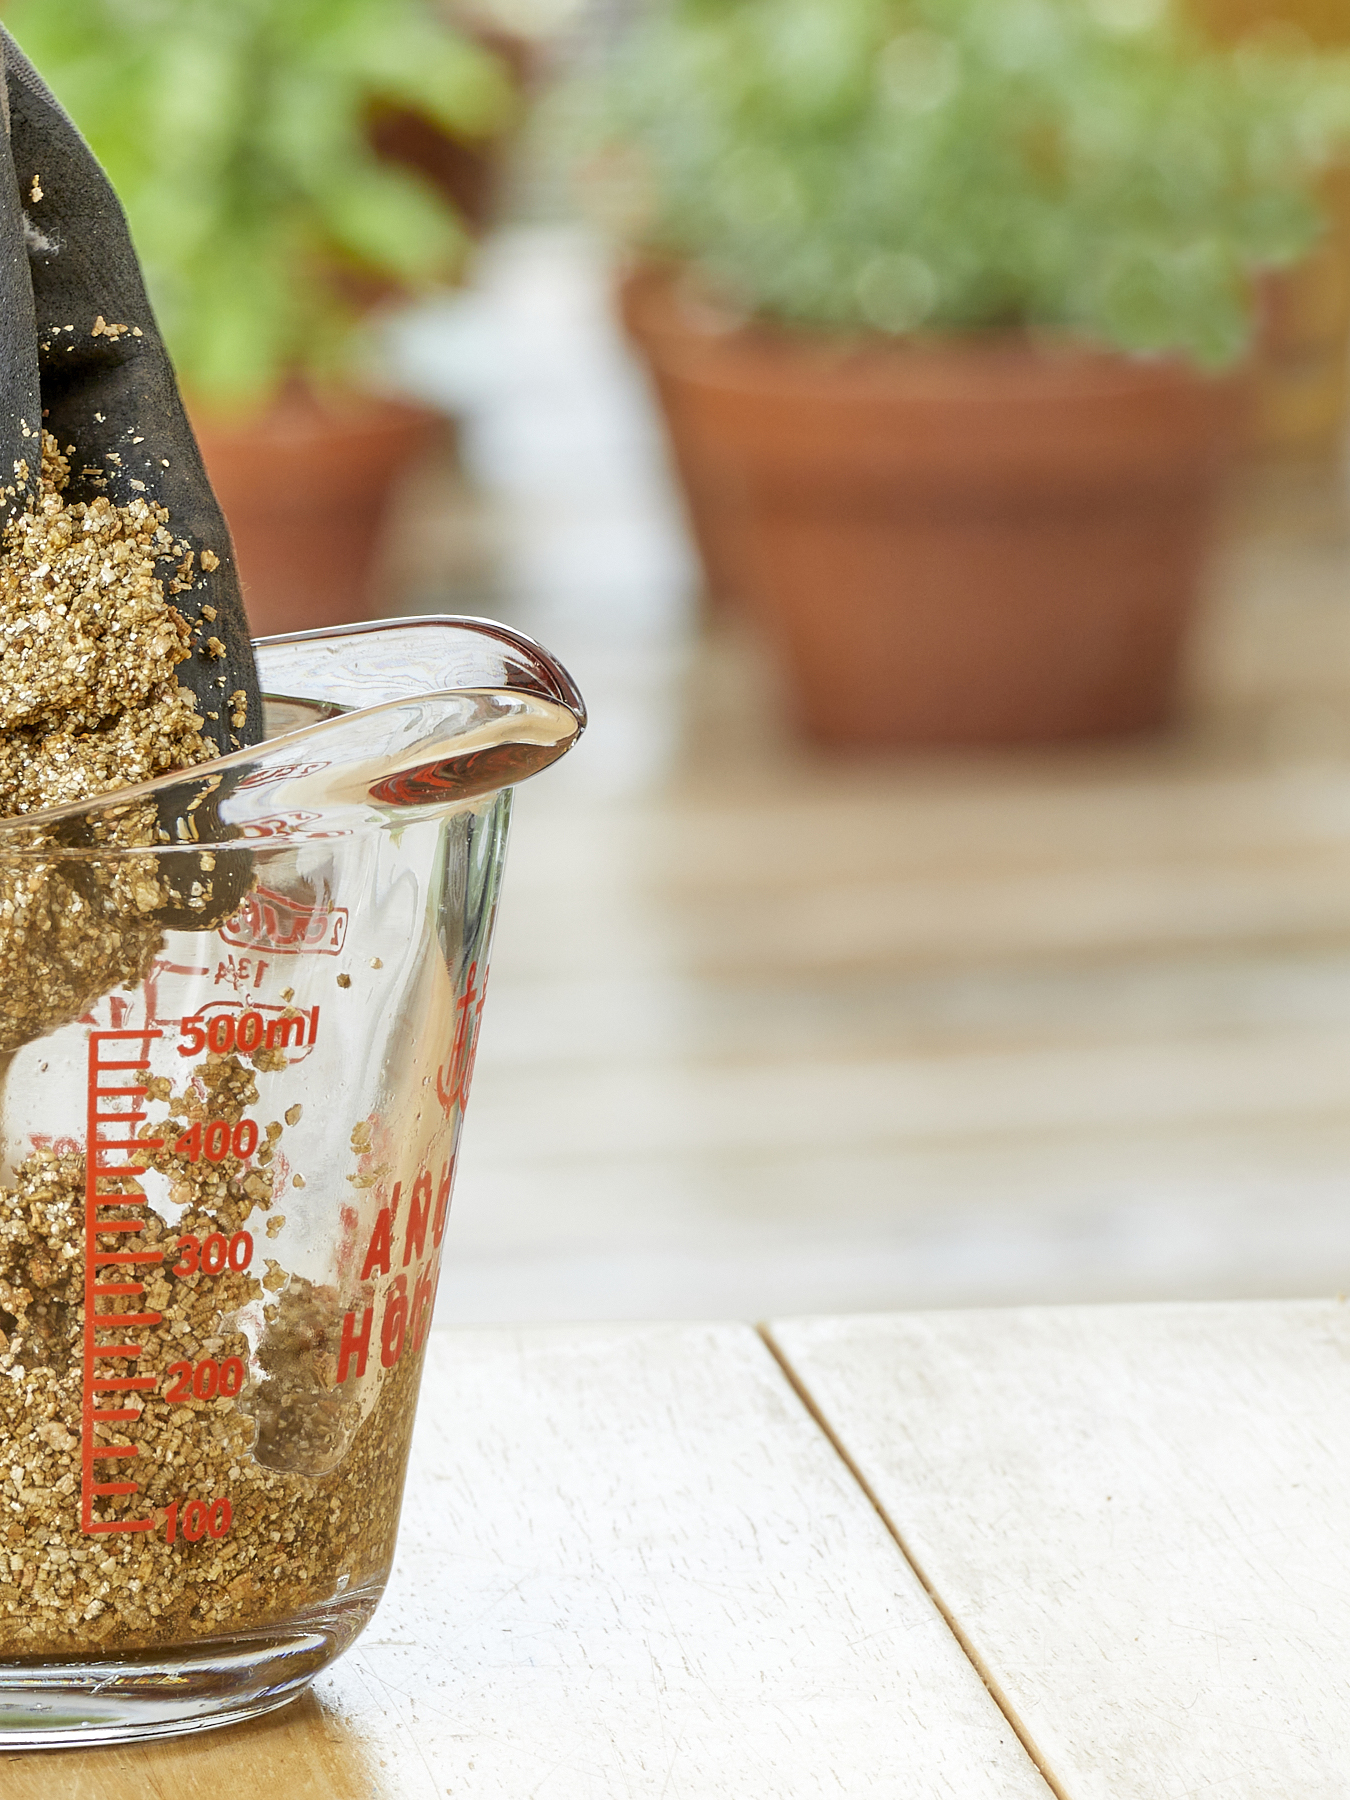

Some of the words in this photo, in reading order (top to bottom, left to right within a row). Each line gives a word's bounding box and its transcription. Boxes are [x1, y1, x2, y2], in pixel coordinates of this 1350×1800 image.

[176, 1005, 320, 1057] 500ml
[175, 1119, 259, 1163] 400
[172, 1230, 254, 1277] 300
[165, 1356, 245, 1403] 200
[164, 1498, 232, 1543] 100
